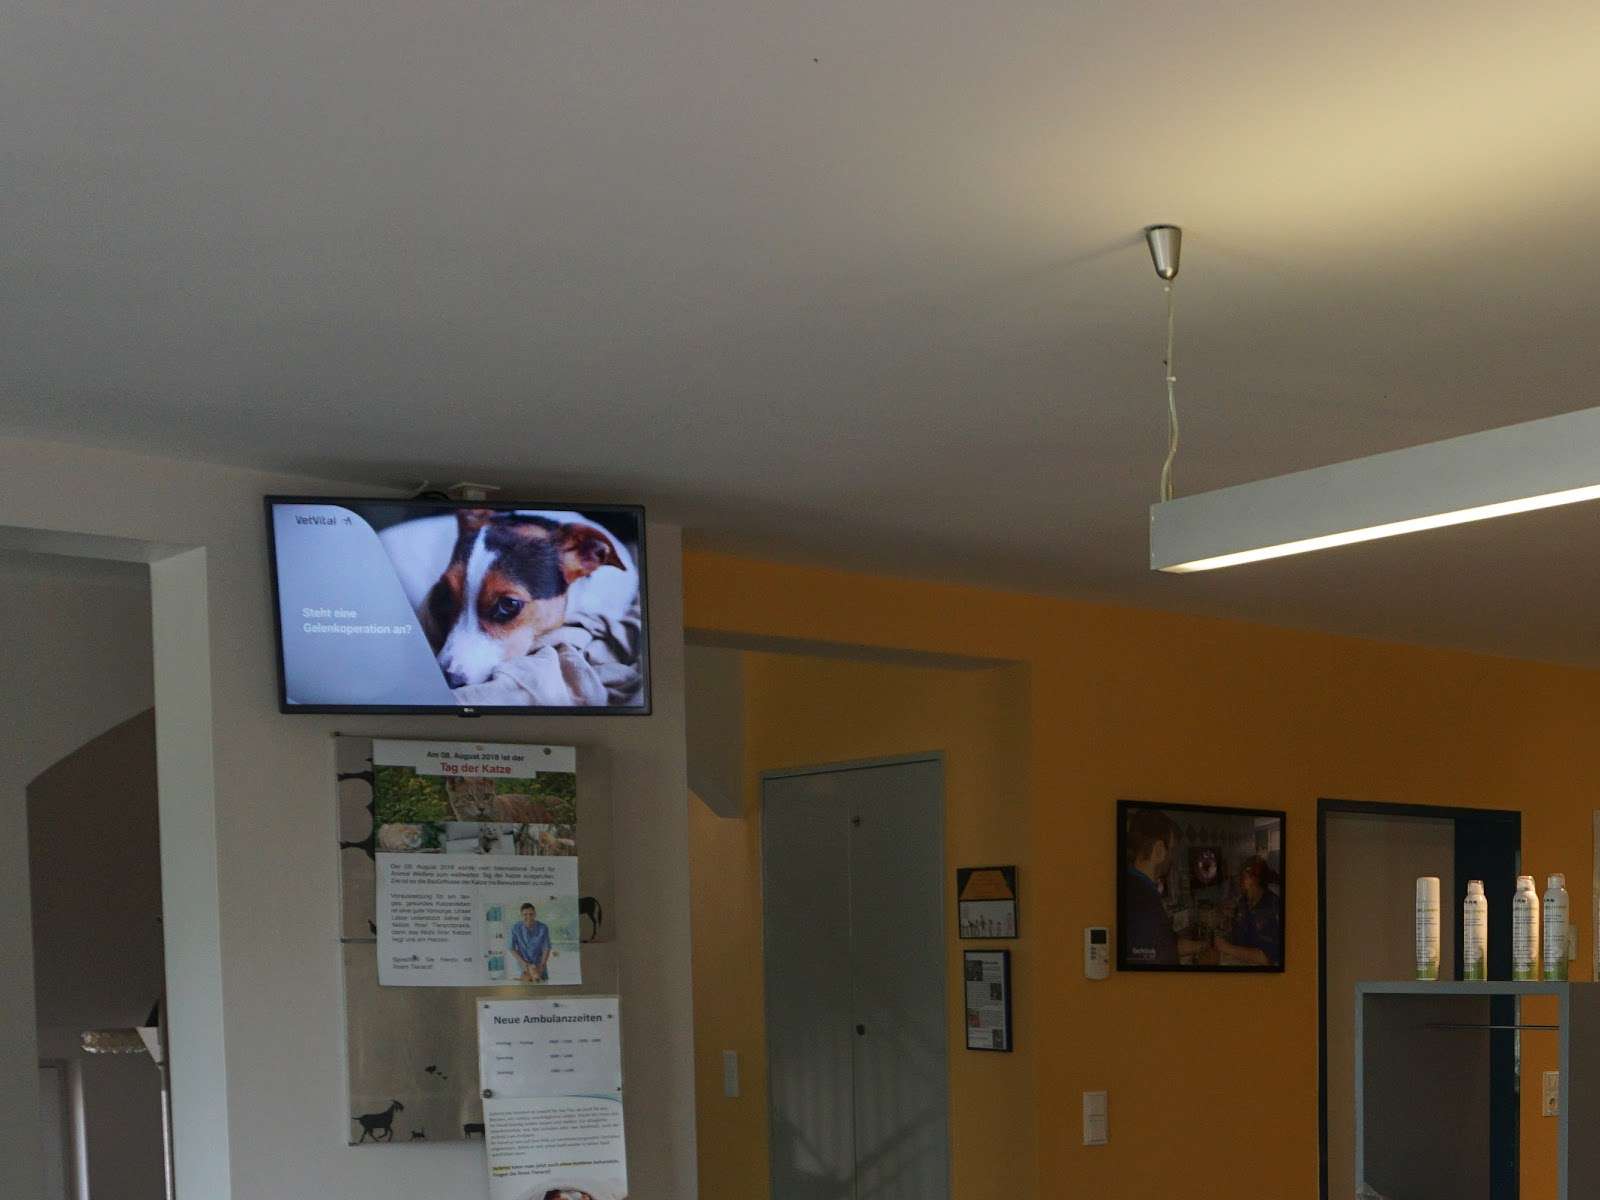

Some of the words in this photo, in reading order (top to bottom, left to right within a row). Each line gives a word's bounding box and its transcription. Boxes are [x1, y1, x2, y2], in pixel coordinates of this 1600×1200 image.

[302, 607, 332, 618] Steht
[334, 607, 357, 618] eine
[454, 752, 480, 761] August
[441, 762, 459, 775] Tag
[461, 762, 478, 773] der
[481, 764, 512, 774] Katze
[494, 1016, 521, 1024] Neue
[523, 1013, 602, 1024] Ambulanzzeiten
